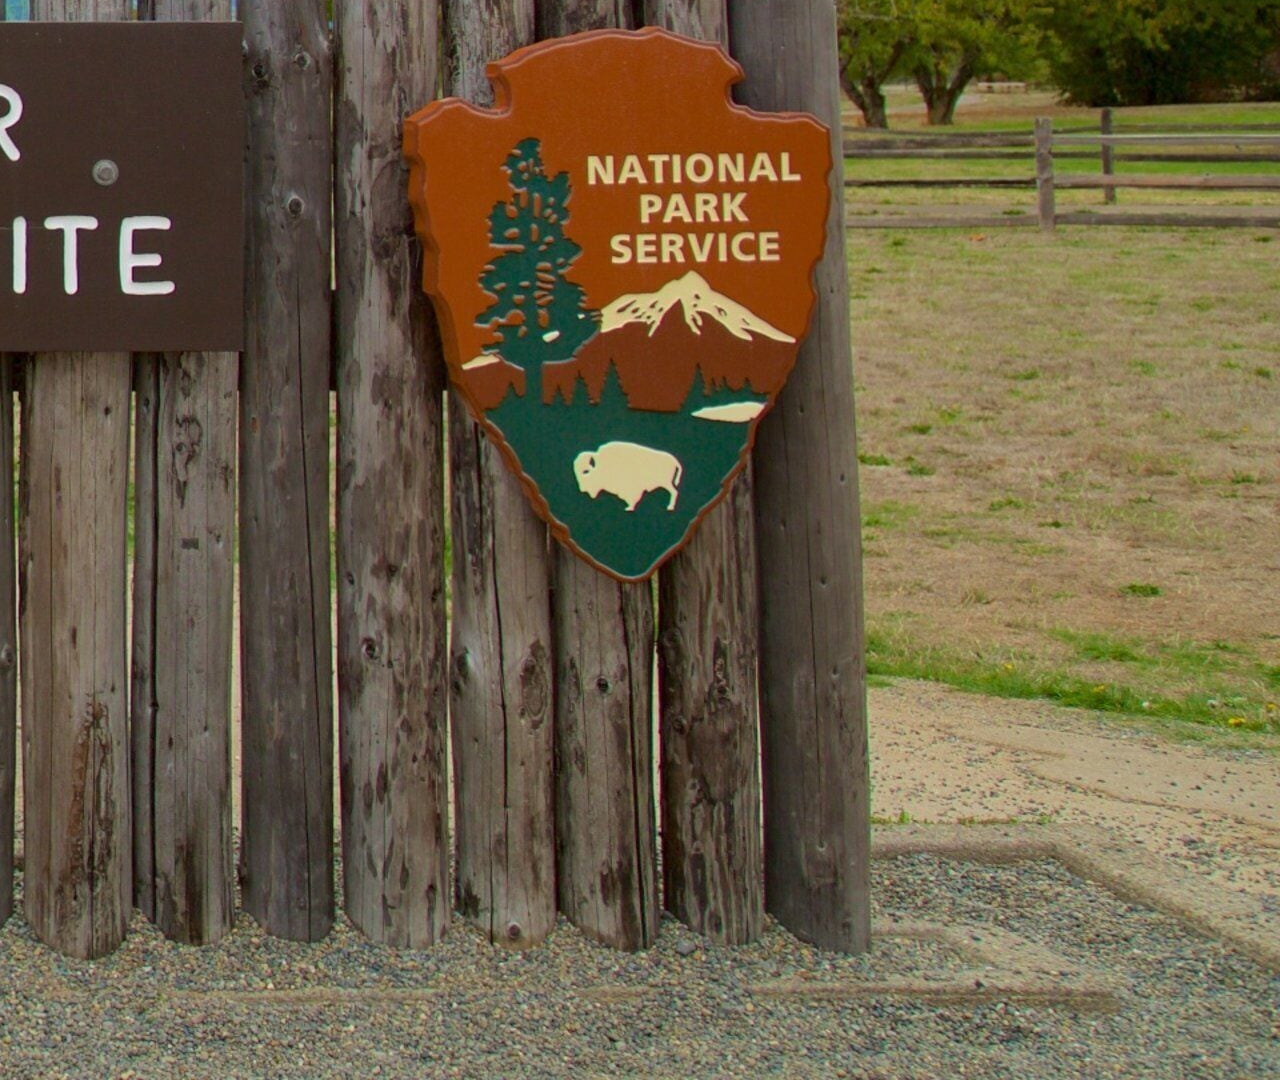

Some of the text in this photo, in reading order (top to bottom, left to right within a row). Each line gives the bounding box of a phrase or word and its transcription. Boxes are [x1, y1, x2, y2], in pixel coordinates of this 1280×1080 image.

[587, 152, 801, 185] NATIONAL
[640, 192, 749, 223] PARK
[610, 232, 781, 264] SERVICE
